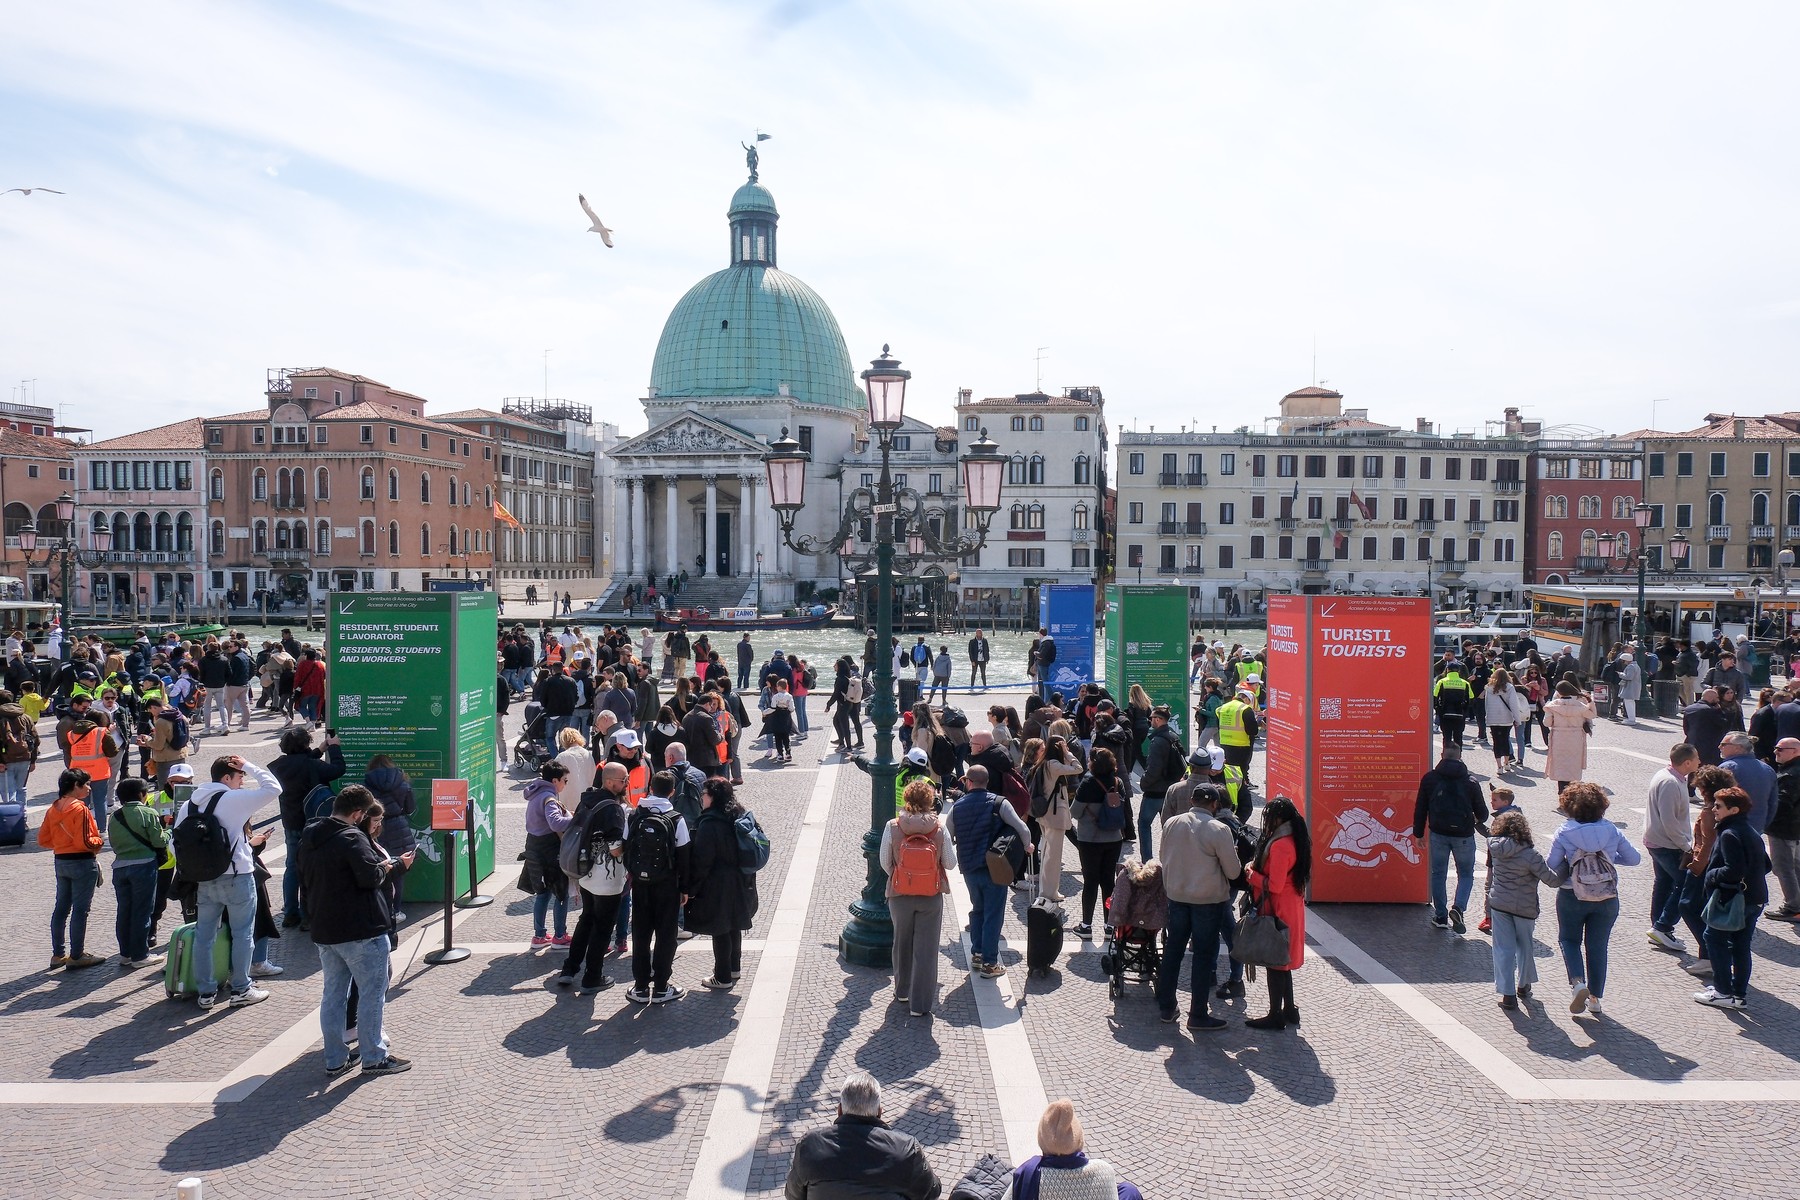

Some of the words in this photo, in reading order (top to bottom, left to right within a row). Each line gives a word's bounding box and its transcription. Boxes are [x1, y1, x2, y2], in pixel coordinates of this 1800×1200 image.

[1535, 604, 1539, 612] C
[1270, 624, 1293, 638] TURISTI
[1321, 628, 1390, 641] TURISTI
[1271, 639, 1298, 654] TOURISTS
[1322, 644, 1407, 657] TOURISTS
